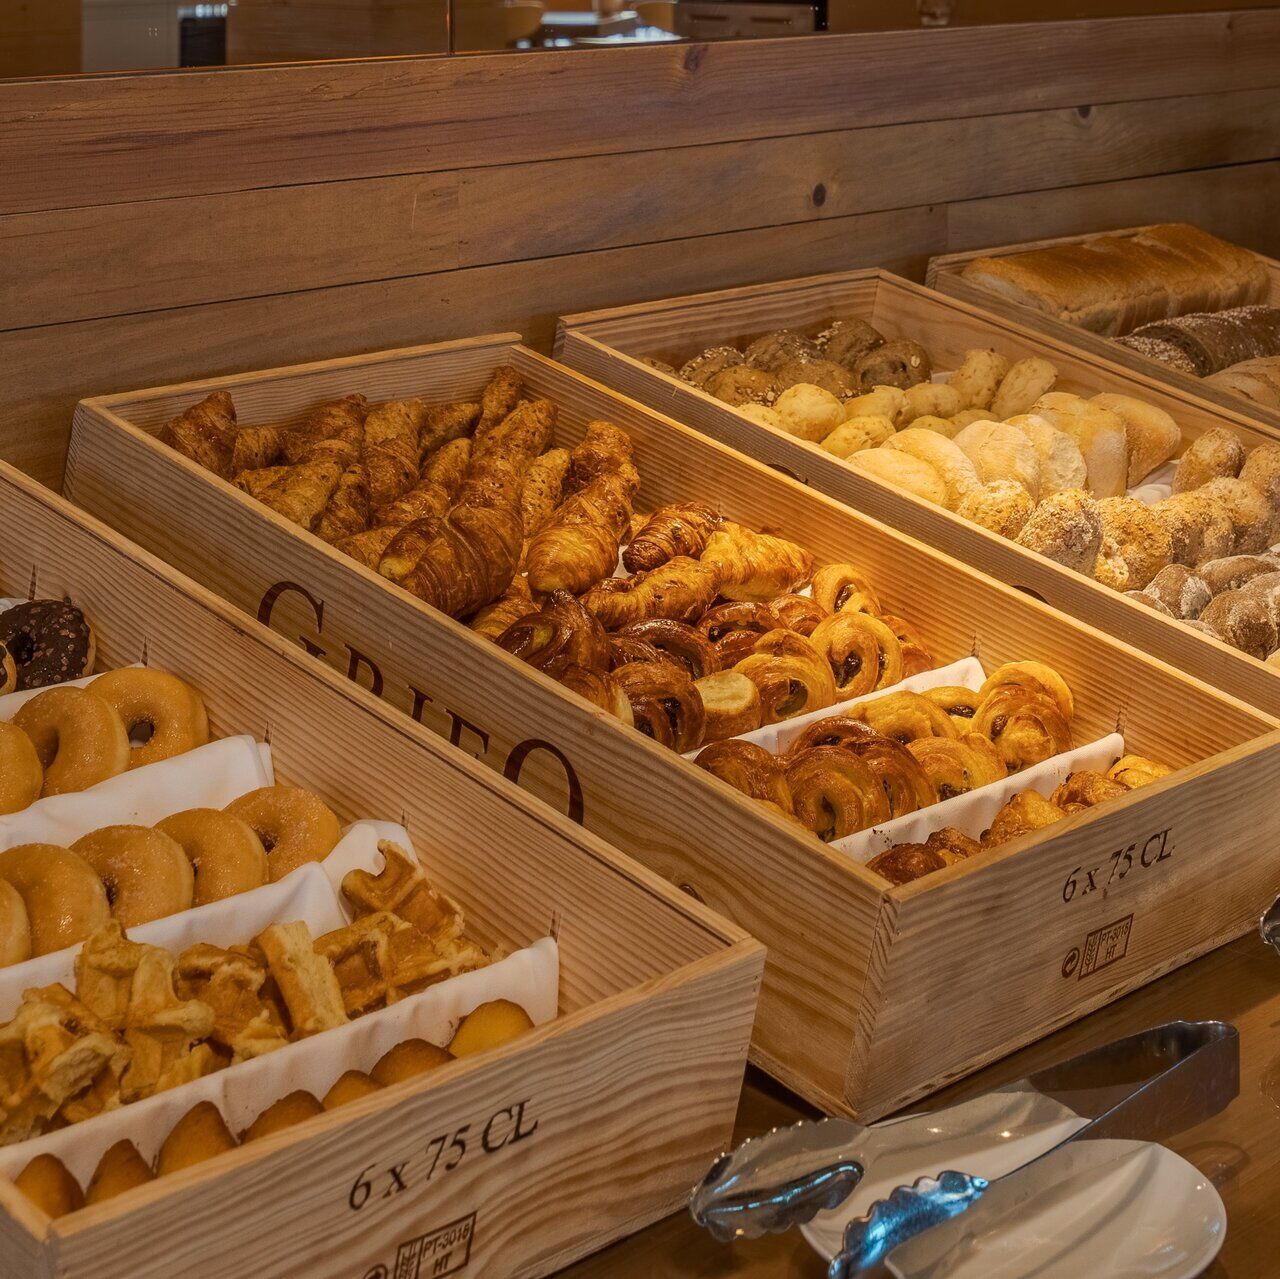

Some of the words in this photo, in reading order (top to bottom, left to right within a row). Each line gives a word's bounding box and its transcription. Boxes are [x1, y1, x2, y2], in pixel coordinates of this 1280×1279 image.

[1062, 866, 1082, 903] 6
[1081, 867, 1100, 896] x
[1108, 843, 1137, 885] 75
[1140, 828, 1176, 868] CL
[348, 1163, 375, 1211] 6
[382, 1161, 411, 1199] x
[425, 1124, 471, 1181] 75
[481, 1099, 538, 1154] CL
[433, 1251, 453, 1275] HT
